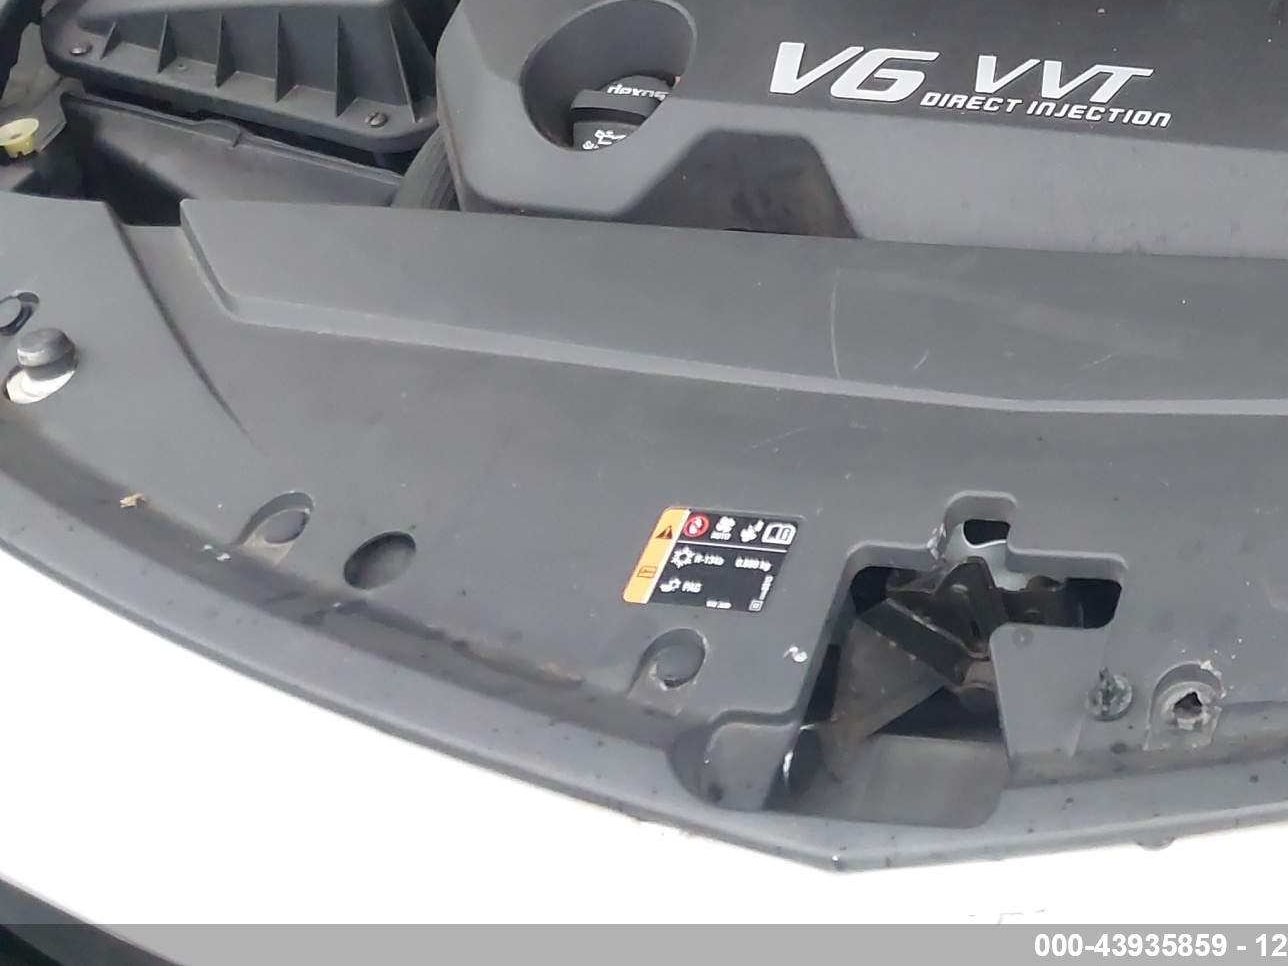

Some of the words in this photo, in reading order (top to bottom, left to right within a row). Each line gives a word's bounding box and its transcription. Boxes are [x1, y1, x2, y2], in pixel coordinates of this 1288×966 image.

[769, 41, 940, 103] V6
[975, 55, 1155, 104] VVT
[919, 91, 1023, 112] DIRECT
[1027, 100, 1172, 129] INJECTION
